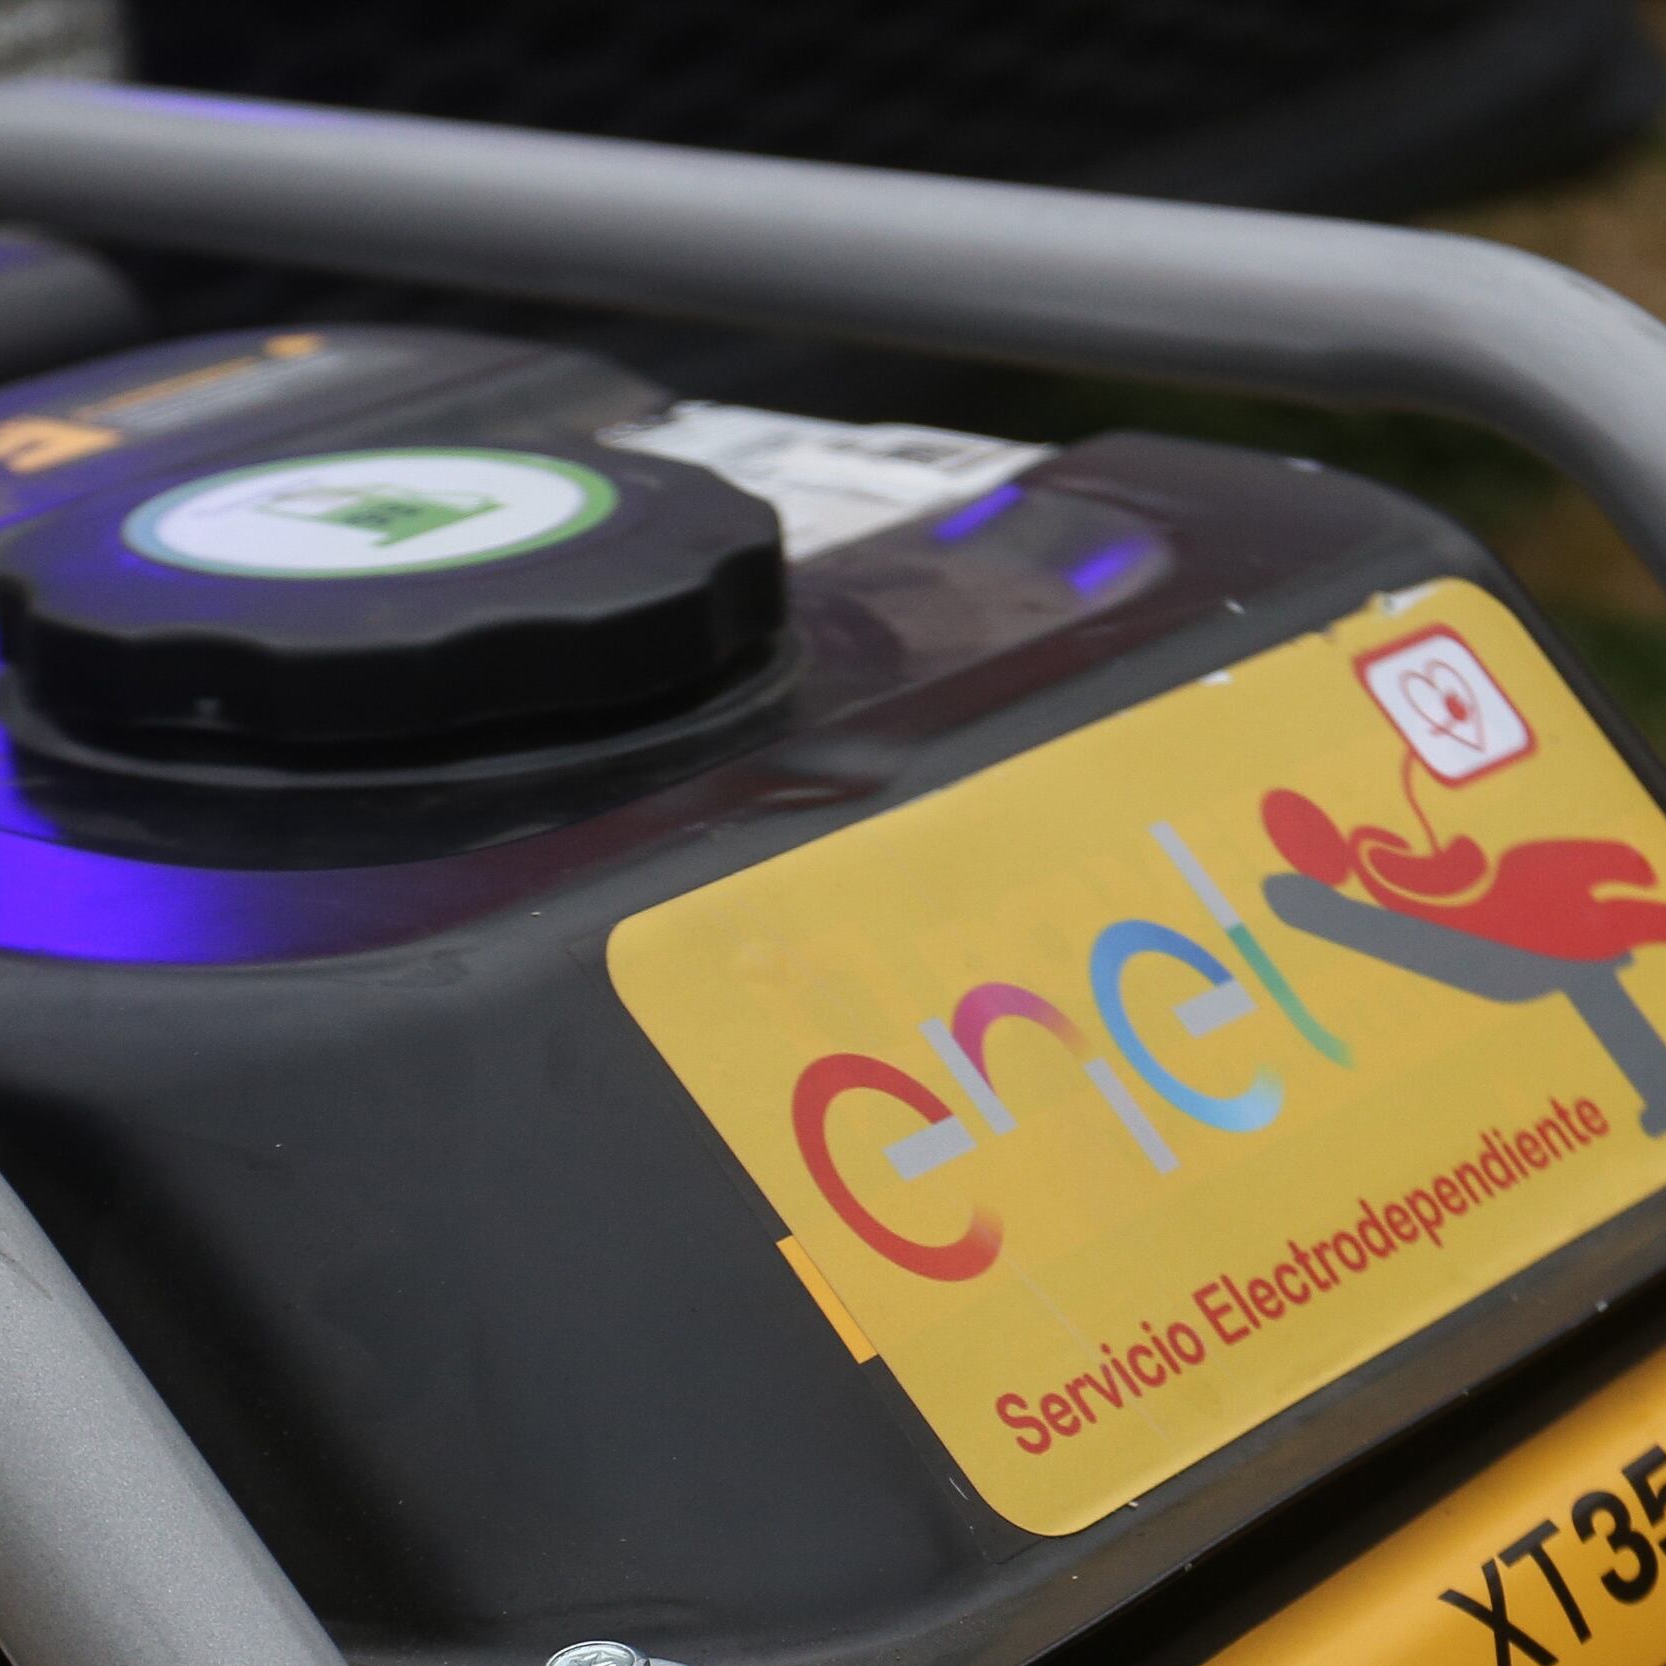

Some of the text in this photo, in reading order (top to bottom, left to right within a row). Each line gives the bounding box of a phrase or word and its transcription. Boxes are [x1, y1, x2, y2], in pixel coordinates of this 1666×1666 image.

[791, 820, 1353, 1282] enel
[995, 1096, 1611, 1455] Servicio Electrodependiente
